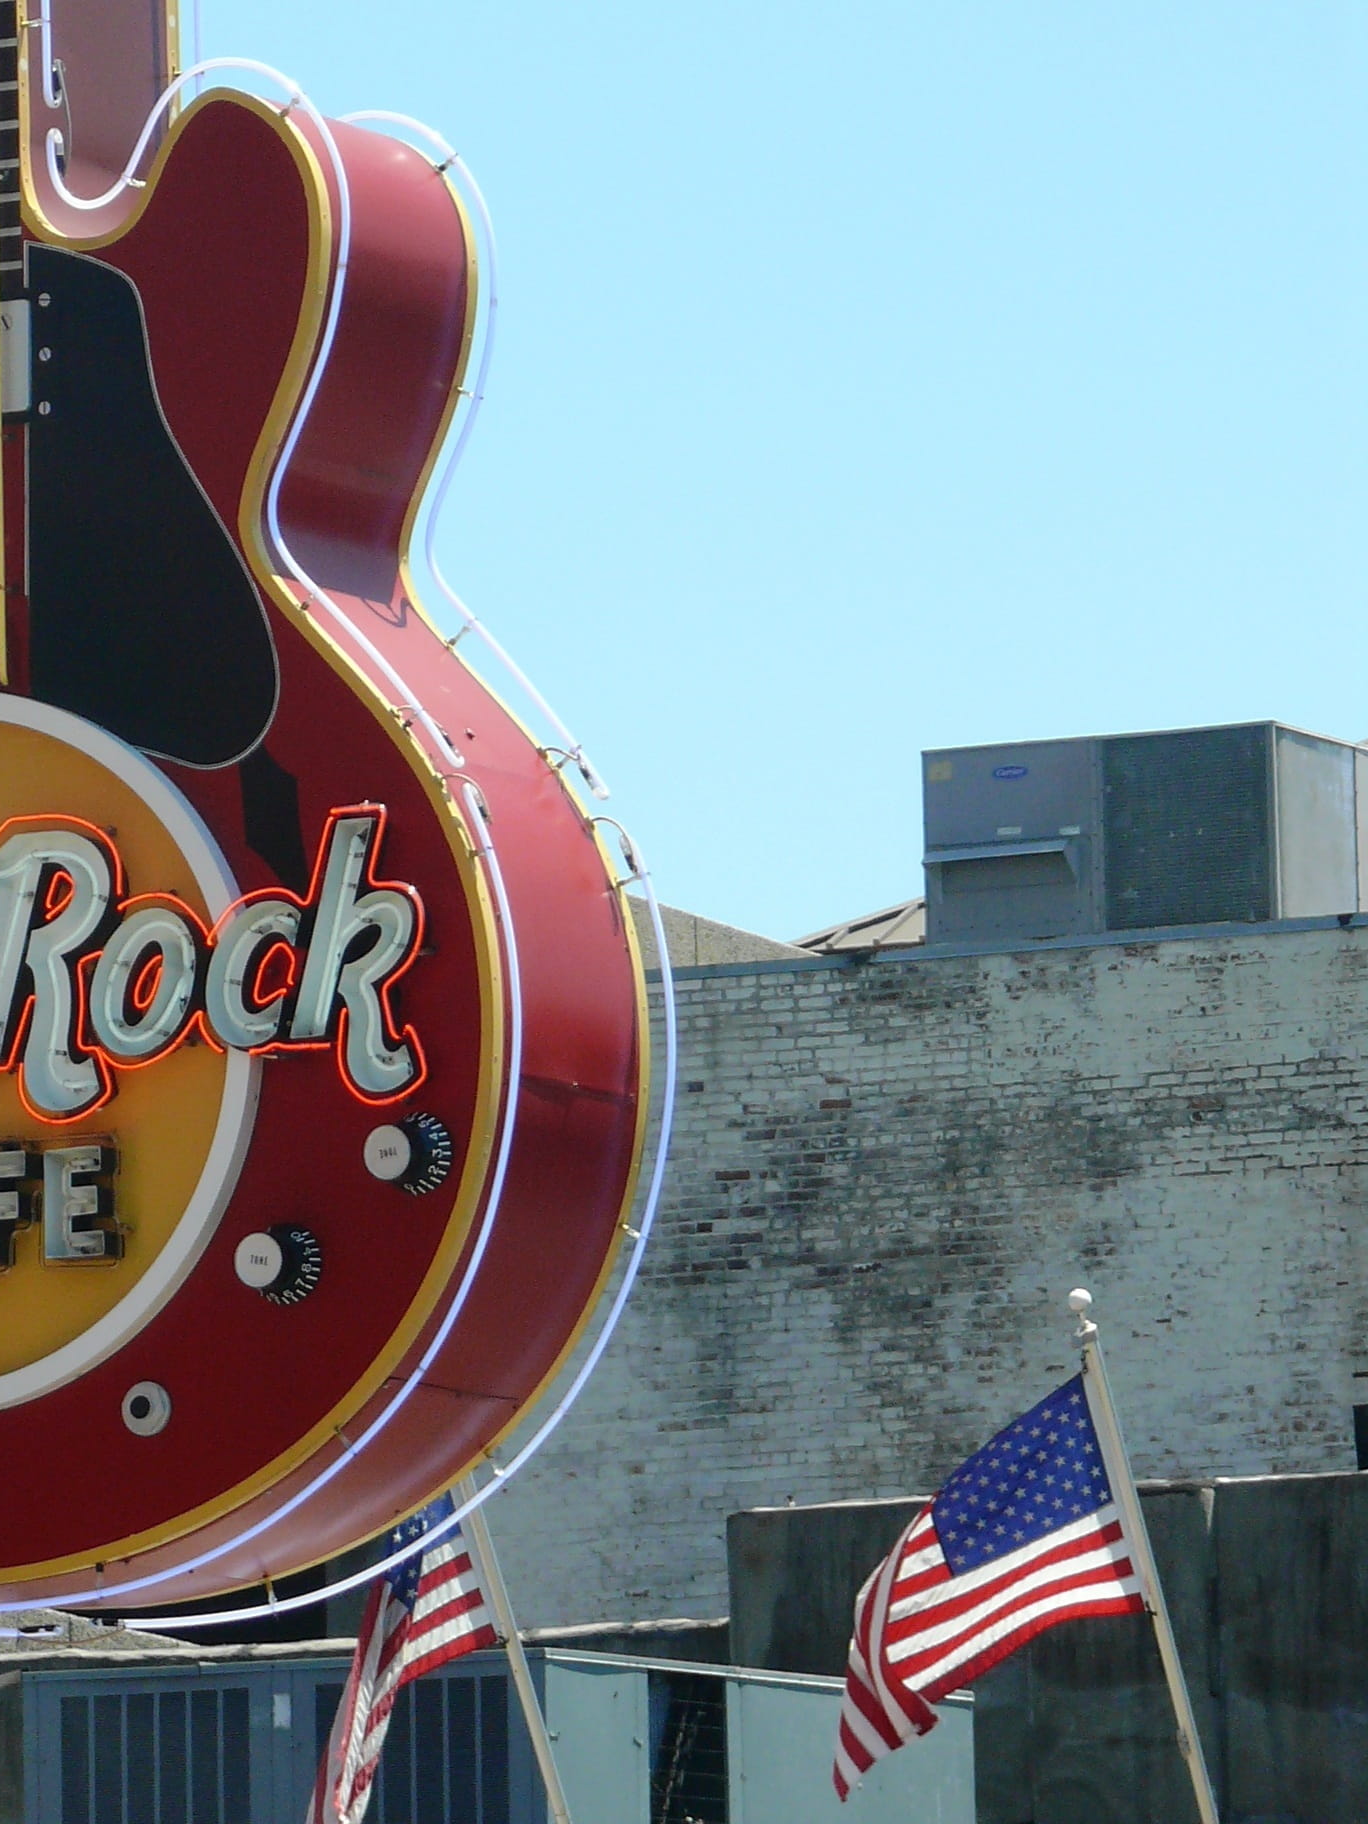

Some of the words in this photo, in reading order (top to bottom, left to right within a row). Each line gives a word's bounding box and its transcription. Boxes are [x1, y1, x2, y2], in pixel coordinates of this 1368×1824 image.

[429, 1132, 438, 1140] 4
[432, 1148, 443, 1158] 3
[295, 1277, 305, 1286] 7
[301, 1263, 312, 1273] 8
